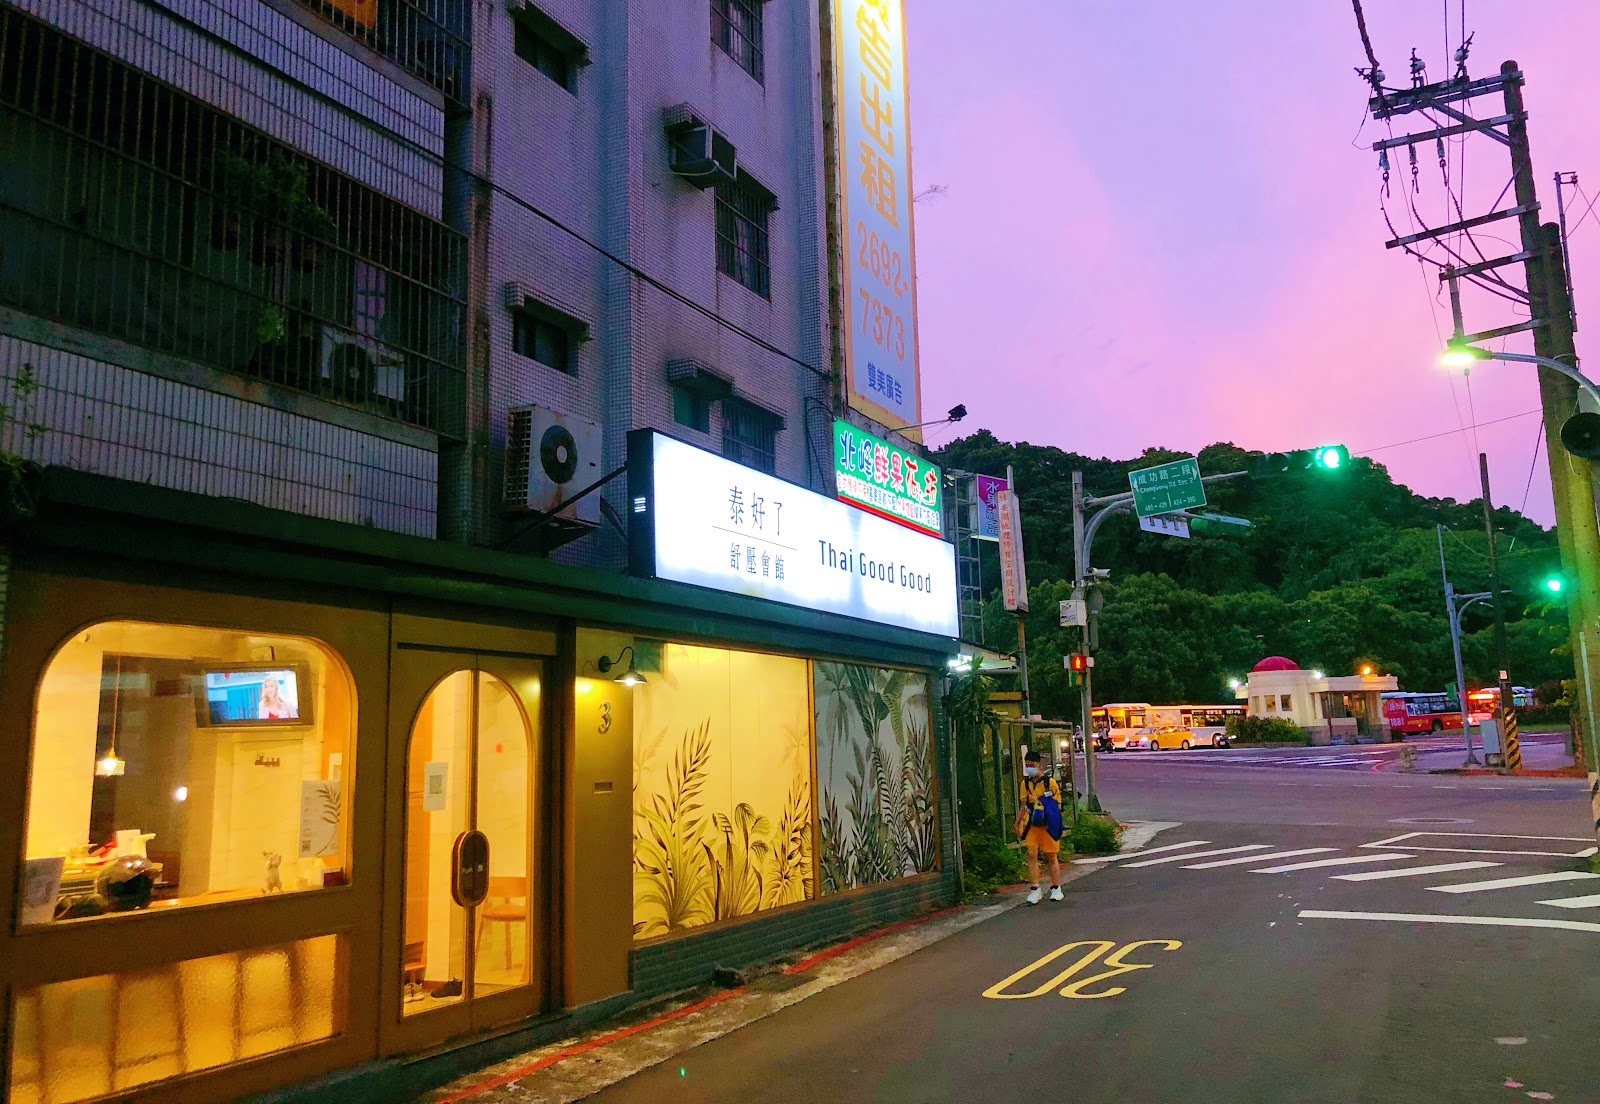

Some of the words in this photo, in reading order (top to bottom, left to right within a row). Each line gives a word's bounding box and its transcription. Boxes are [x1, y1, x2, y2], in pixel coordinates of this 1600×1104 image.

[859, 287, 905, 362] 7373
[867, 361, 903, 406] 雙美廣告
[1138, 465, 1192, 485] 成功路二段
[728, 485, 783, 537] 泰好了
[729, 541, 785, 580] 舒壓會館
[818, 540, 853, 573] Thai
[859, 552, 895, 584] Good
[900, 565, 931, 593] Good
[597, 700, 612, 734] 3
